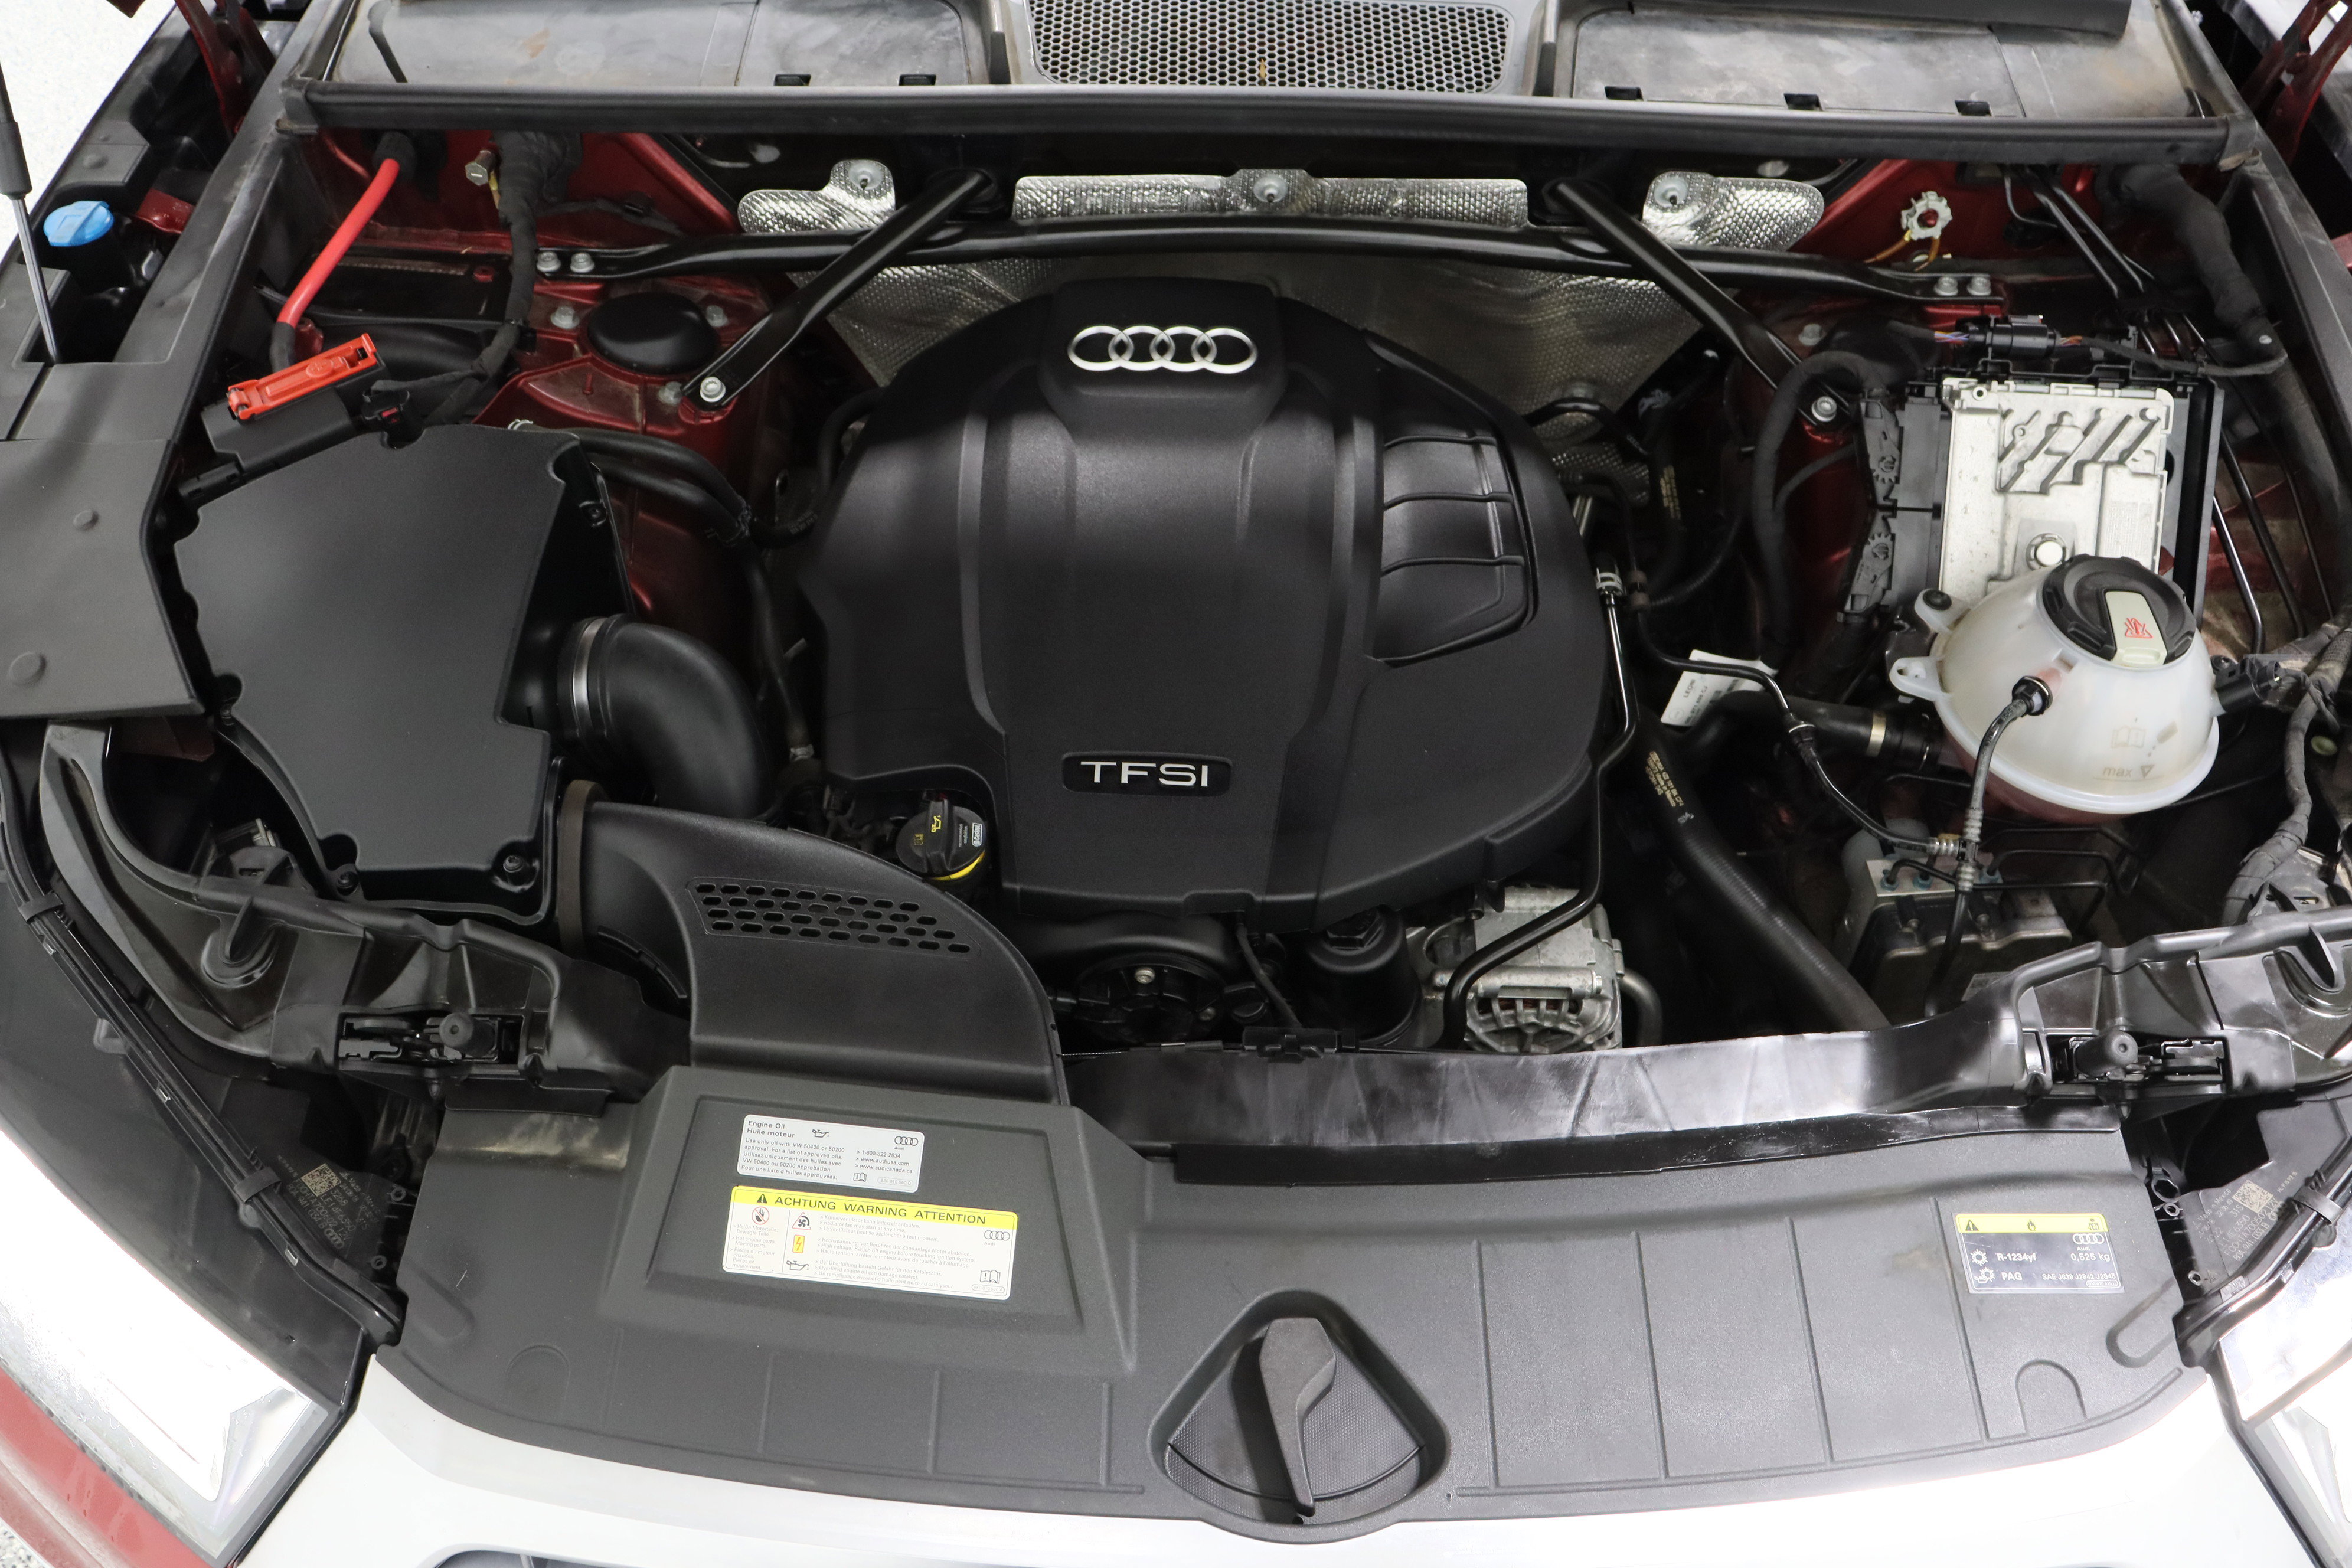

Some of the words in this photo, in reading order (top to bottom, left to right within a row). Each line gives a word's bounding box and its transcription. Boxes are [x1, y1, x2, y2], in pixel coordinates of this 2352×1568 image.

[1081, 761, 1208, 787] TFSI
[2102, 767, 2133, 778] max
[748, 1120, 773, 1128] Engine
[862, 1149, 901, 1158] 1-800-822-2834
[860, 1157, 910, 1167] www.audiusa.com
[860, 1164, 913, 1174] www.audicanada.ca
[774, 1196, 836, 1210] ACHTUNG
[844, 1203, 907, 1217] WARNING
[914, 1210, 986, 1224] ATTENTION
[1997, 1252, 2037, 1263] R-1234yf
[2070, 1252, 2096, 1262] 0,525
[2098, 1253, 2111, 1262] kg
[2001, 1272, 2023, 1281] PAG
